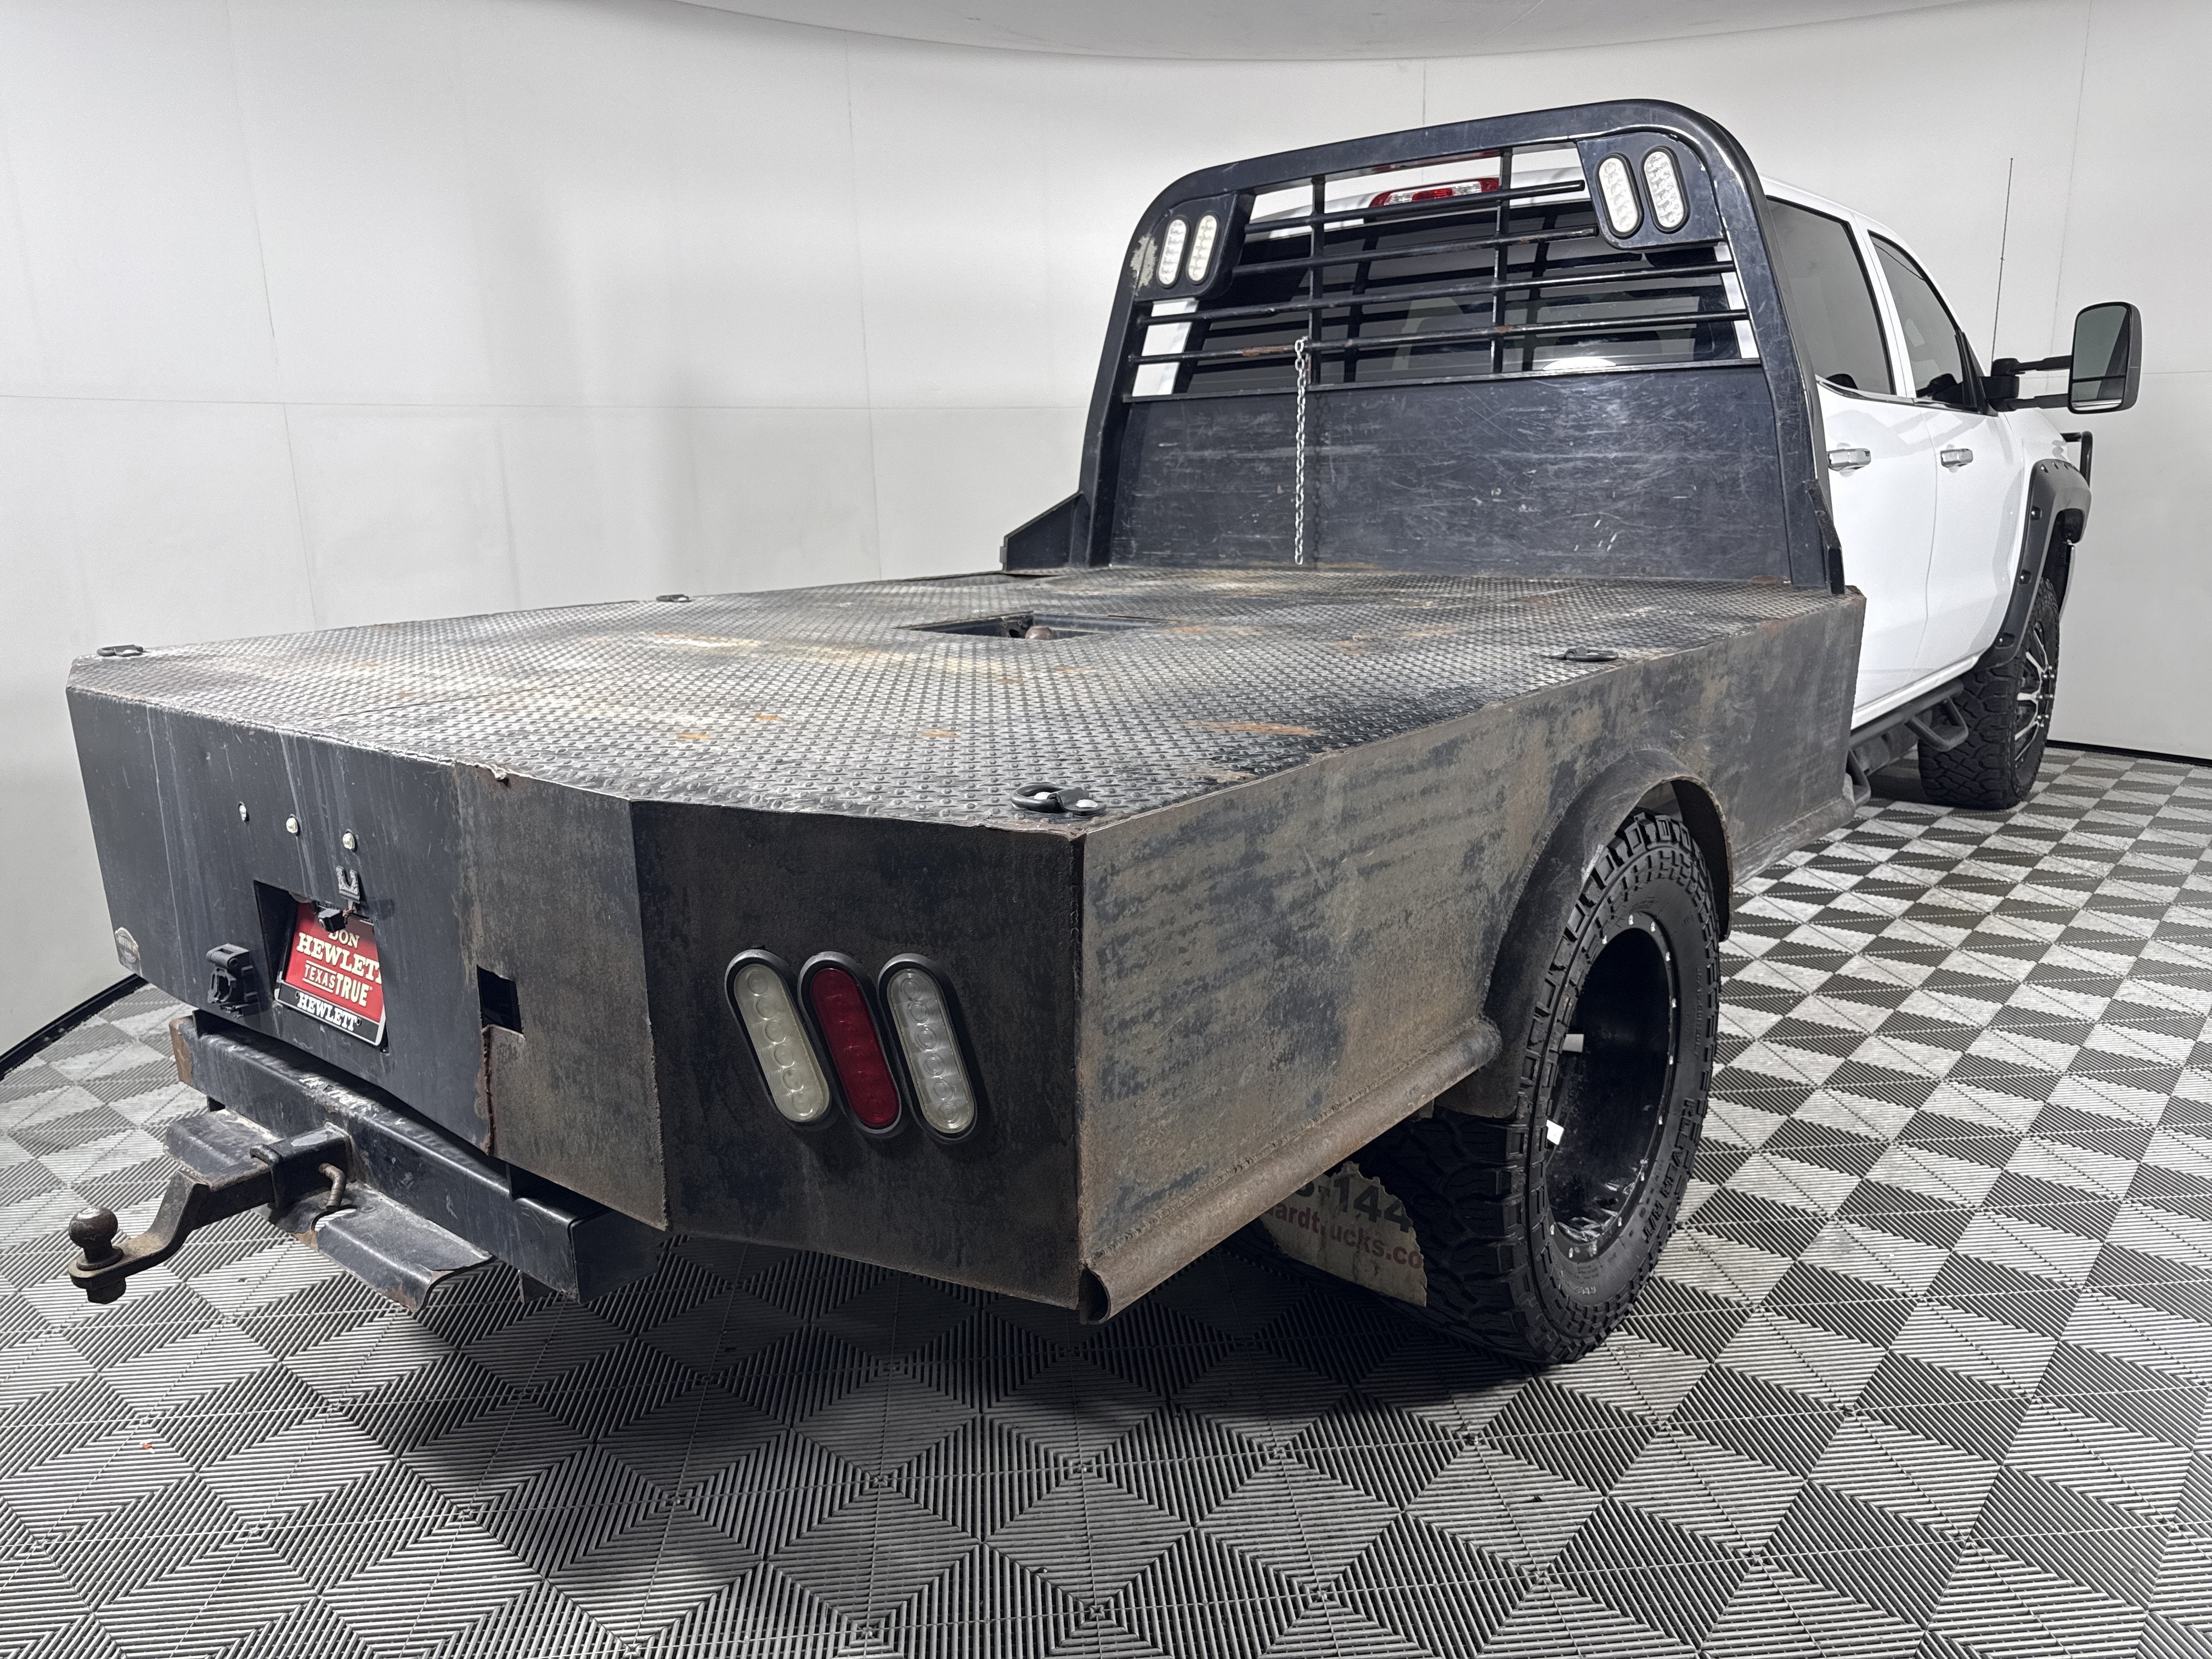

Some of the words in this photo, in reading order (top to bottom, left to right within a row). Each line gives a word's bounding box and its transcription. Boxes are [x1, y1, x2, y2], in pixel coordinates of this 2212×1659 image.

[328, 928, 360, 949] DON
[297, 992, 358, 1031] HEWLETT
[1264, 1202, 1424, 1269] ardtrucks.co
